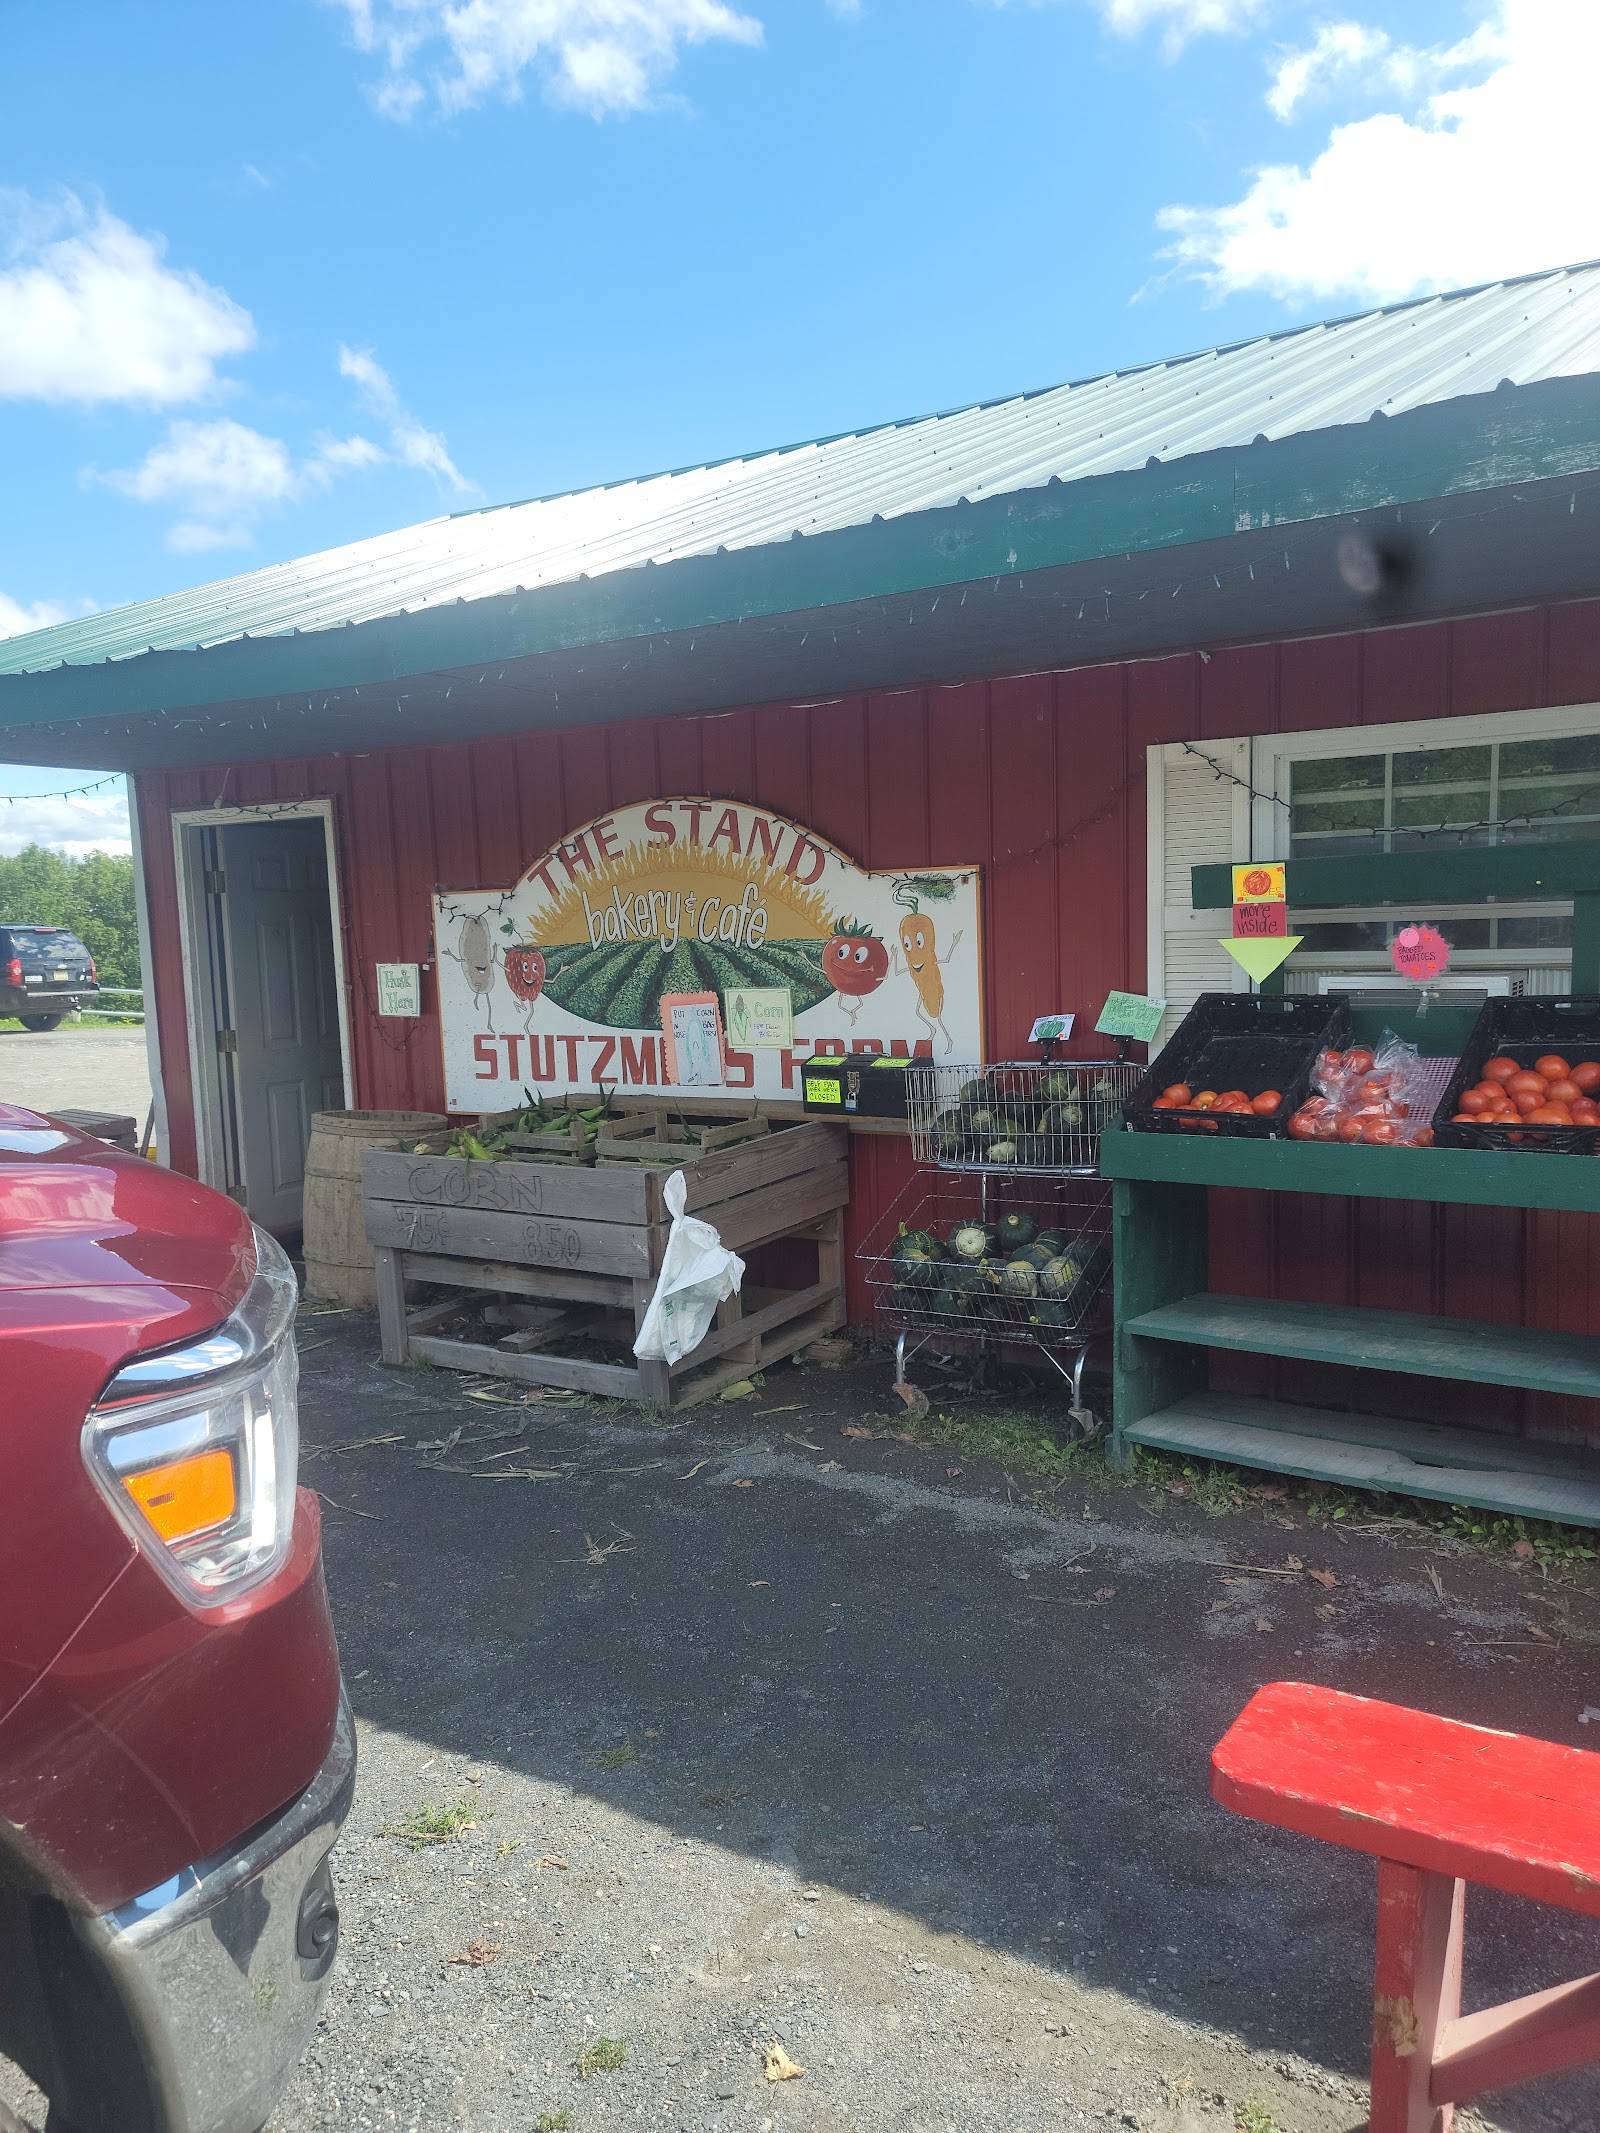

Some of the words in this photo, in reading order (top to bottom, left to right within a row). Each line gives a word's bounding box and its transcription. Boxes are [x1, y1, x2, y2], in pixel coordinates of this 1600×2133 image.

[527, 819, 624, 897] THE
[644, 804, 826, 886] STAND
[582, 886, 681, 953] bakery
[684, 891, 697, 928] &
[698, 882, 768, 950] café
[1240, 904, 1271, 919] more
[1237, 917, 1278, 935] inside
[673, 1009, 685, 1018] PUT
[753, 1001, 784, 1018] Corn
[473, 1034, 755, 1088] STUTZMS
[809, 1092, 836, 1101] CLOSED
[408, 1163, 543, 1212] CORN
